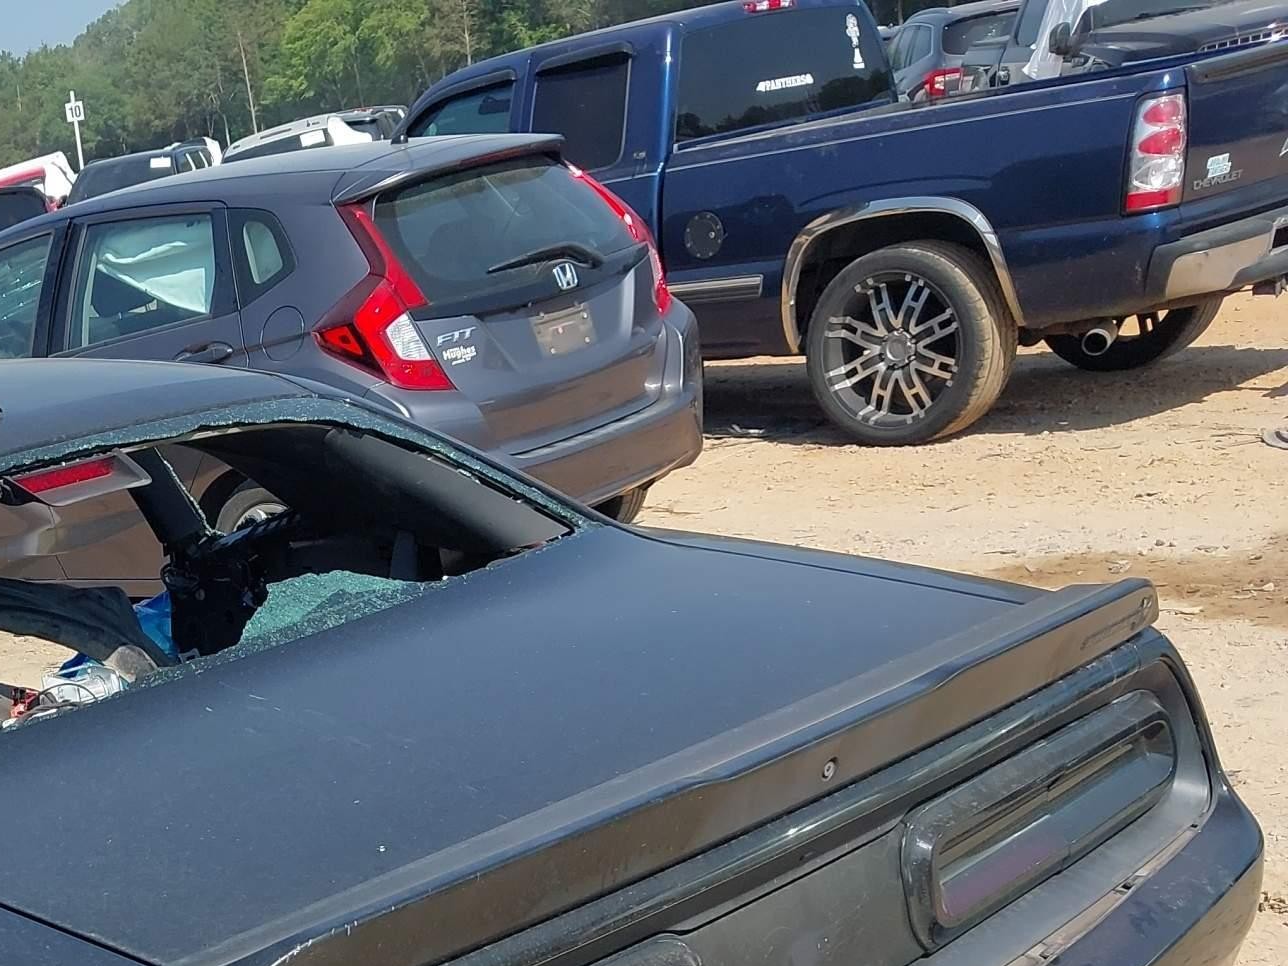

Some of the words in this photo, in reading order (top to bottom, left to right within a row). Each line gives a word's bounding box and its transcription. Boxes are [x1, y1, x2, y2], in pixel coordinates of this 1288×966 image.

[68, 105, 81, 118] 10
[1193, 168, 1244, 190] CHEVROLET
[437, 326, 477, 346] FIT
[442, 345, 476, 361] Hughes
